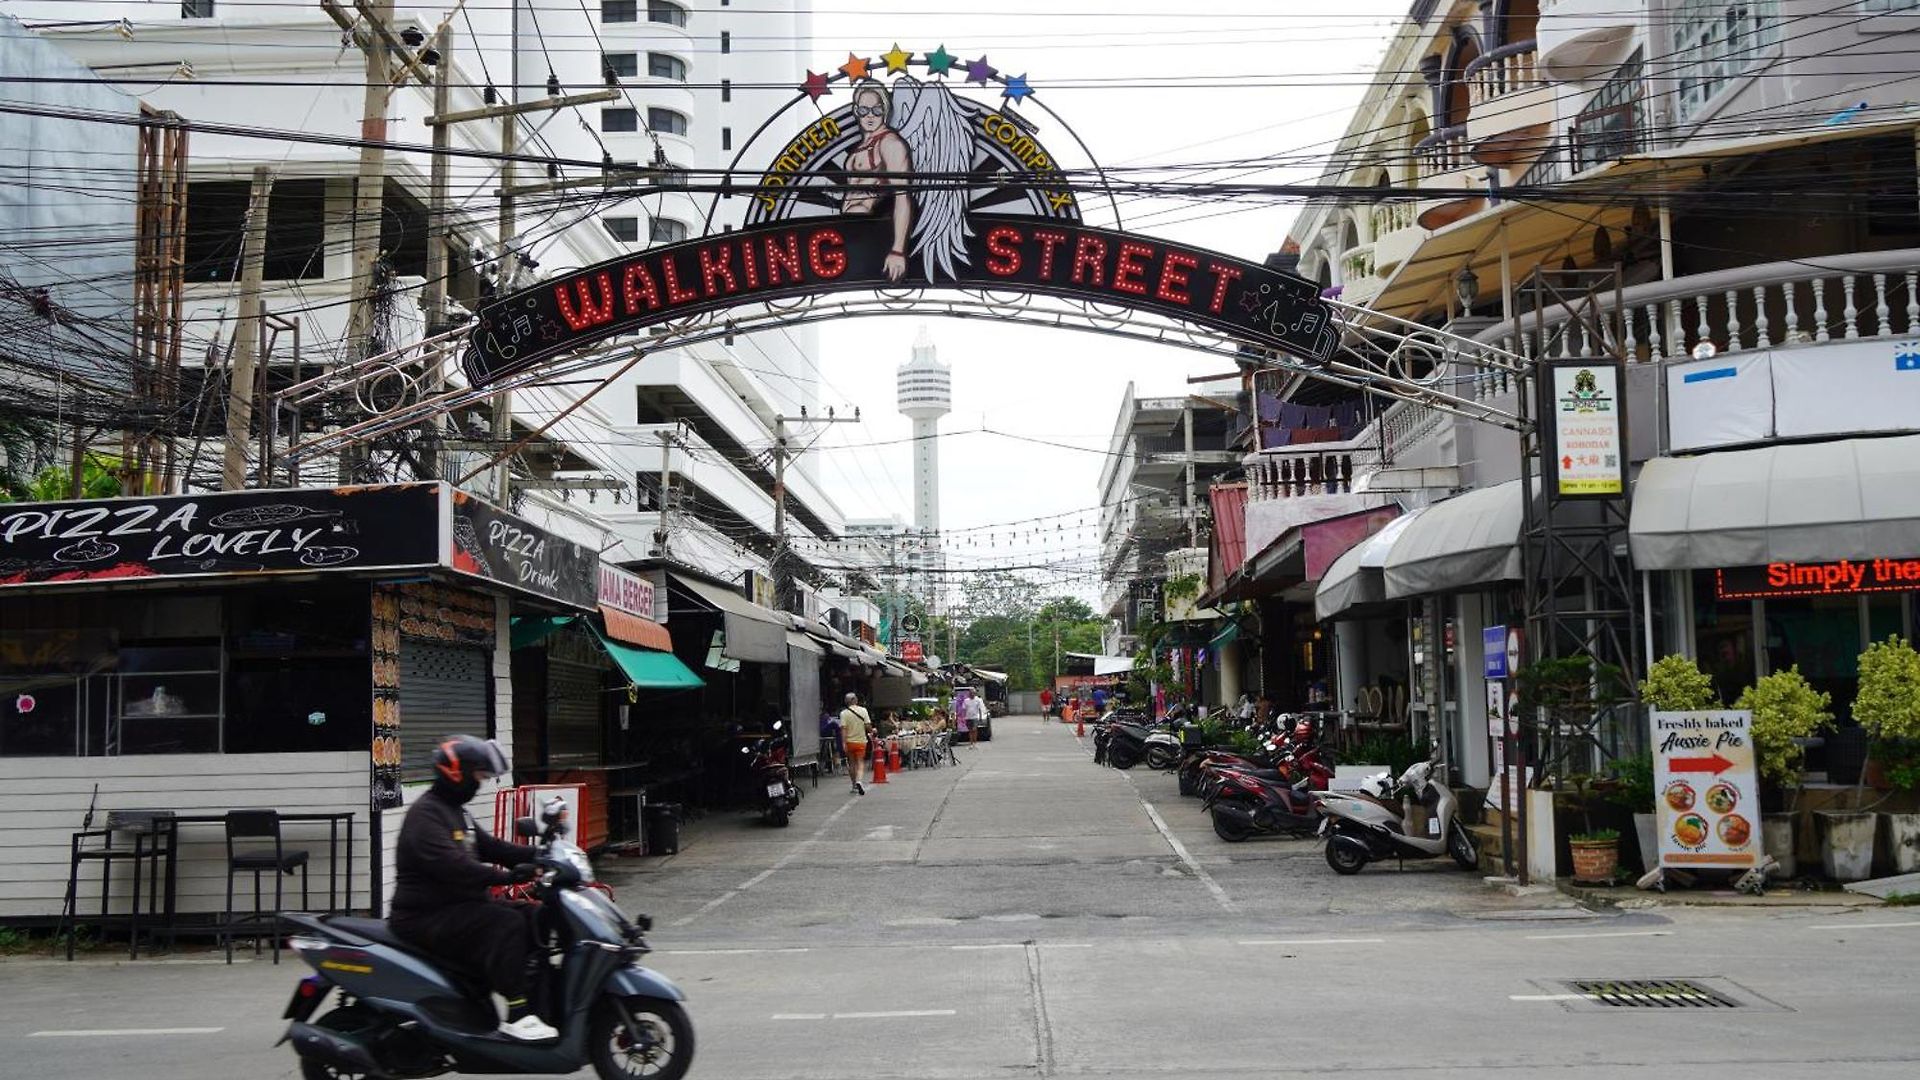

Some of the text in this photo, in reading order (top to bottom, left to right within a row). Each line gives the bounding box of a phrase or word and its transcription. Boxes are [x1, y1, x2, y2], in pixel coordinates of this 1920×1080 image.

[555, 226, 1244, 332] WALKING STREET
[1, 503, 199, 542] PIZZA
[148, 528, 322, 561] LOVELY
[489, 520, 545, 561] PIZZA
[520, 560, 559, 592] Drink
[1767, 556, 1920, 590] Simply the
[623, 577, 654, 617] BERGER
[1658, 716, 1744, 732] Freshly baked
[1660, 730, 1744, 753] Aussie Pie
